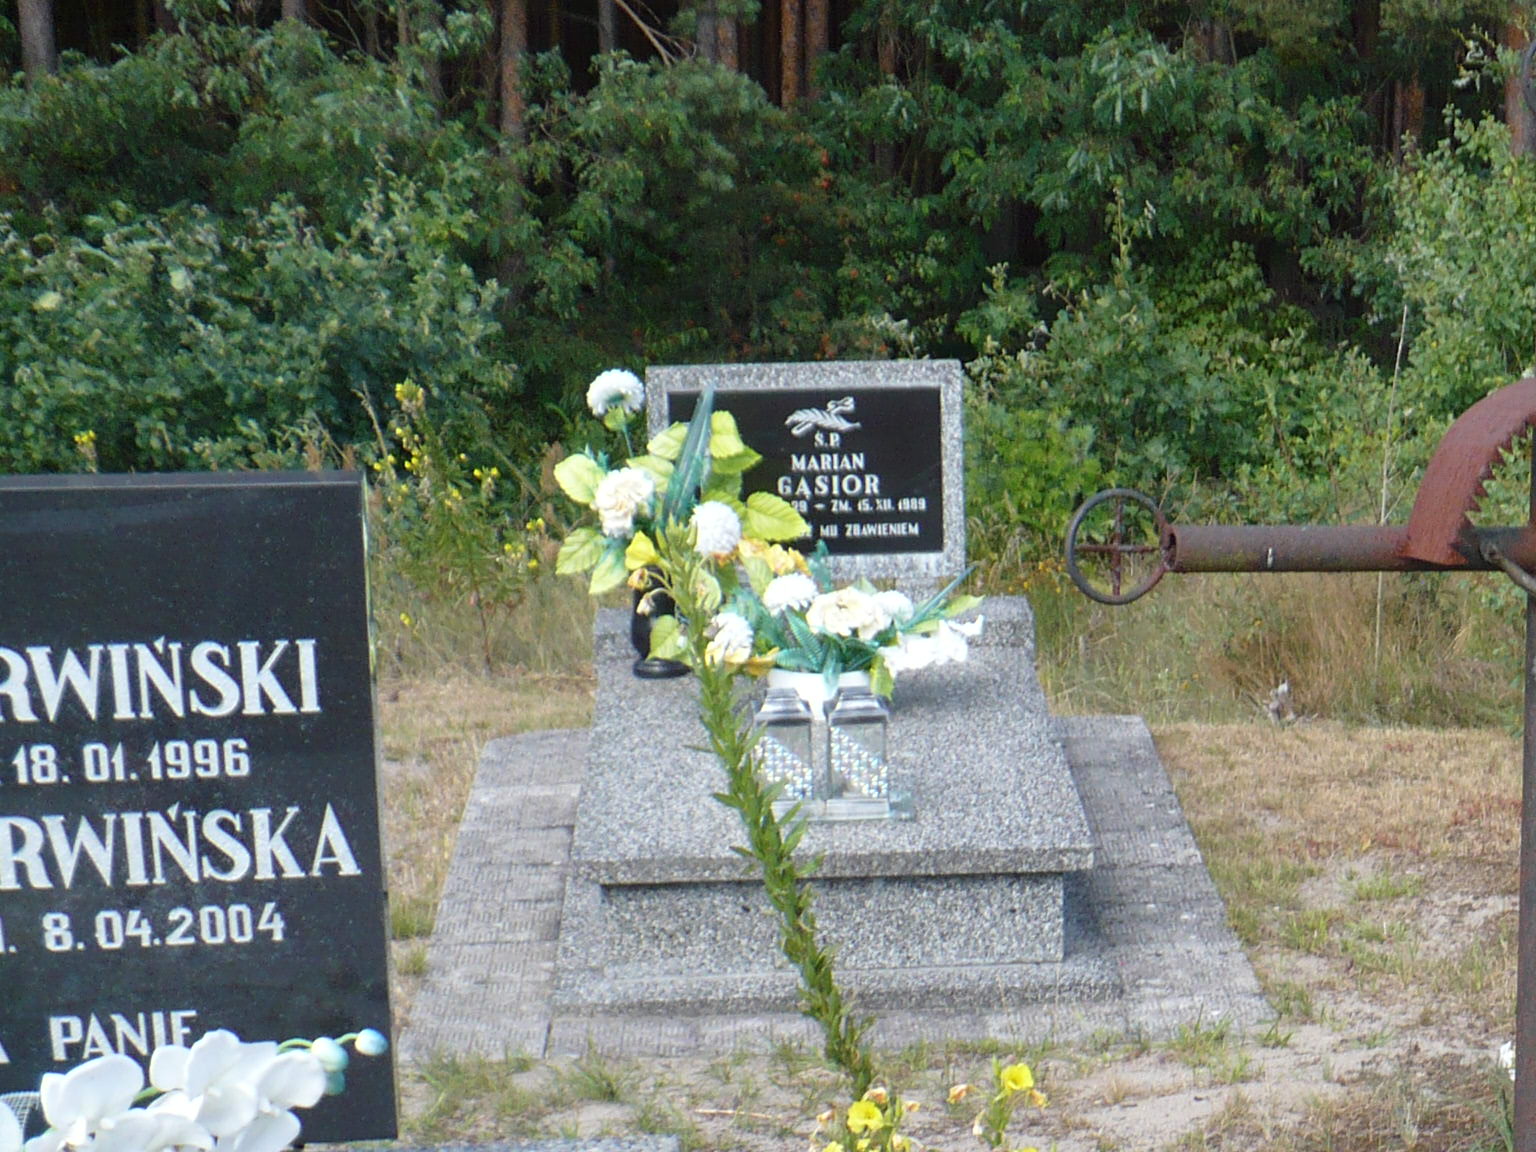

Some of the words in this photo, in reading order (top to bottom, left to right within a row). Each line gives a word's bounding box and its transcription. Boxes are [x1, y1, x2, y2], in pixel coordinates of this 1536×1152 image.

[791, 452, 865, 471] MARIAN
[777, 474, 880, 499] GĄSIOR
[831, 499, 852, 513] ZM.
[897, 497, 927, 511] 1989
[819, 523, 839, 537] MU
[845, 521, 919, 537] ZBAWIENIEM
[0, 802, 361, 890] RWIŃSKA
